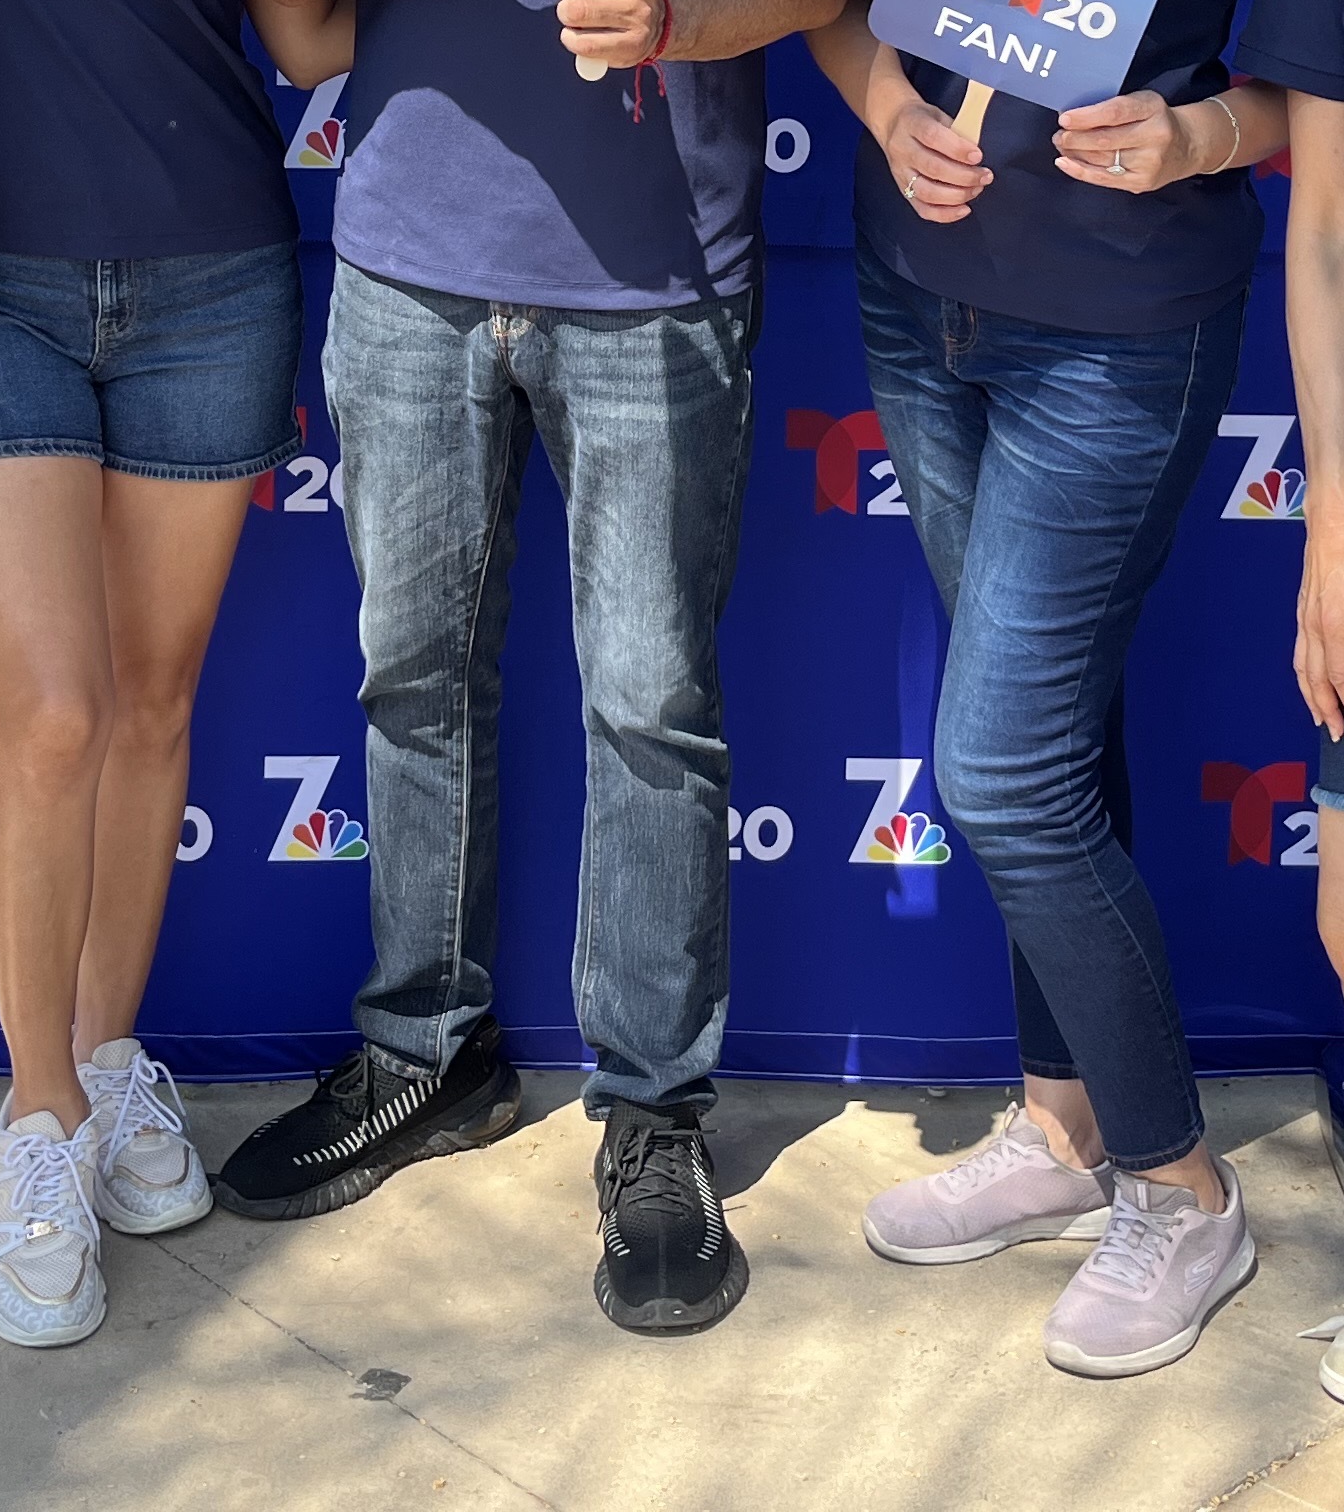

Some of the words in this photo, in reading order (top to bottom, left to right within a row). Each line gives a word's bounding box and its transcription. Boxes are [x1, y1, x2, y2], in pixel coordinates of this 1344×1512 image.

[933, 6, 1058, 79] FAN!
[1217, 415, 1296, 520] 7
[263, 755, 341, 862] 7
[845, 757, 923, 863] 7
